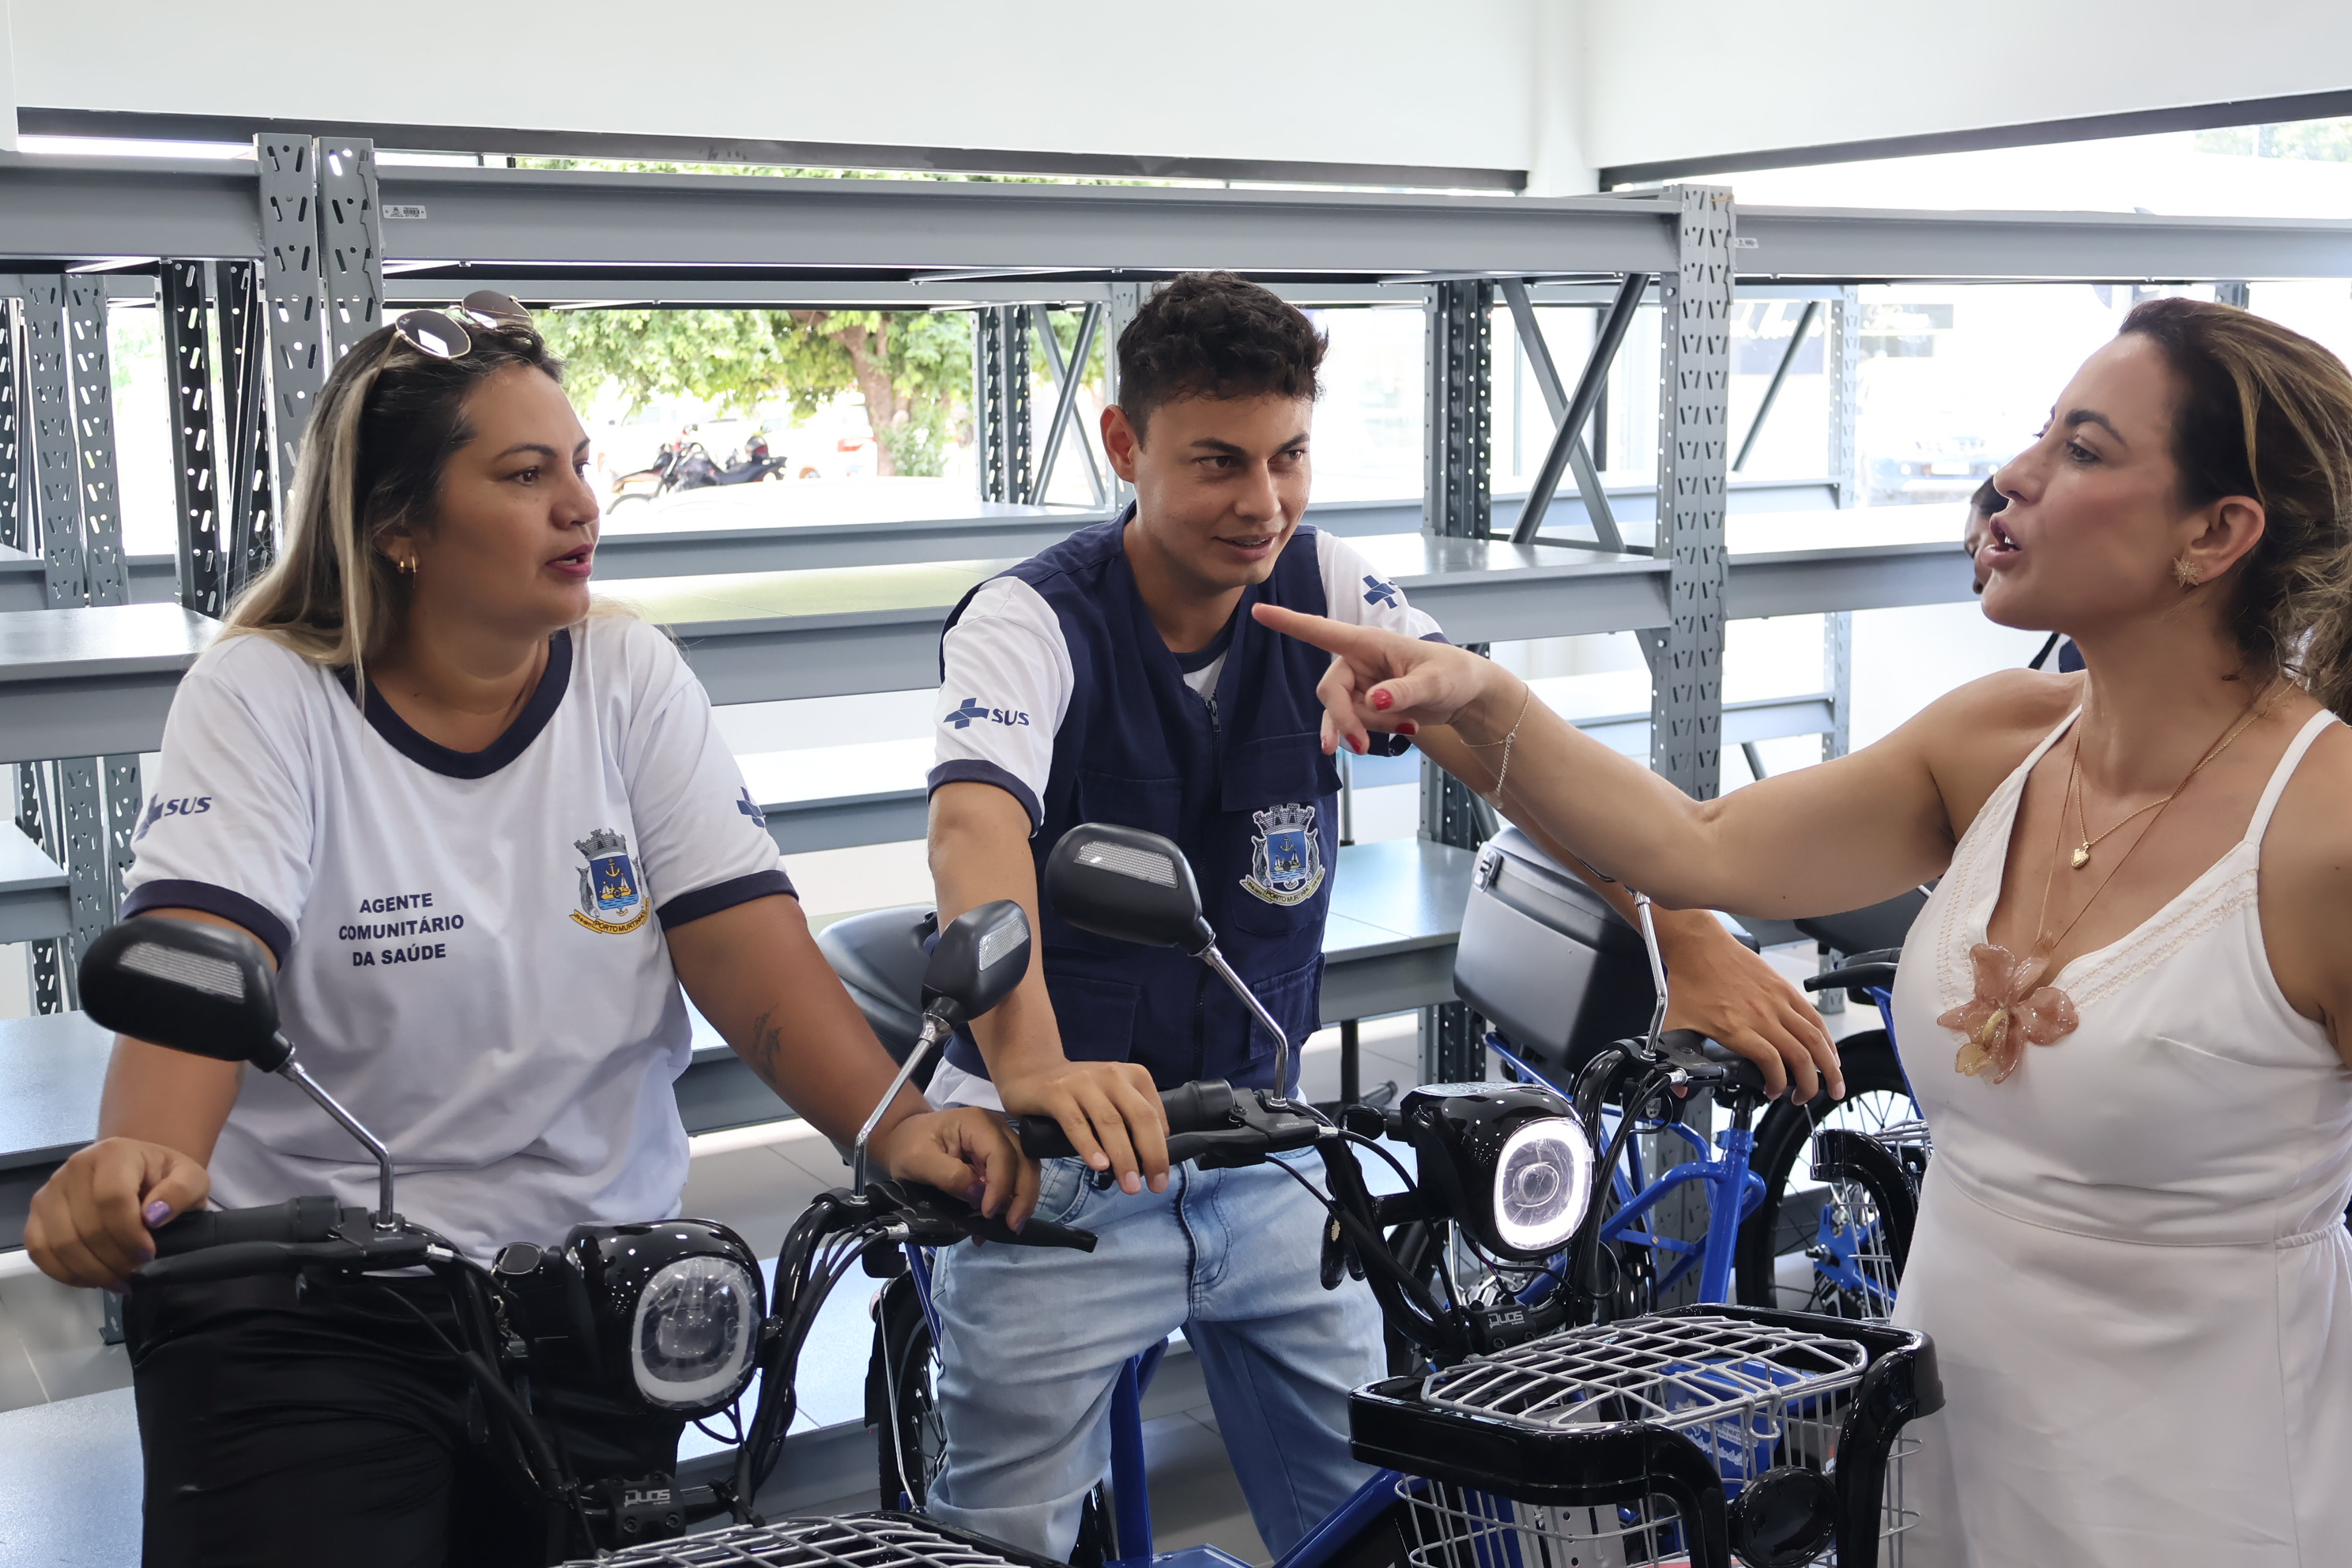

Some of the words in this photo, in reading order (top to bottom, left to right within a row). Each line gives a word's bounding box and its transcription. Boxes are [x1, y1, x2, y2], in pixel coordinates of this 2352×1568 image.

[991, 708, 1030, 726] SUS
[164, 796, 212, 817] SUS
[359, 892, 433, 914] AGENTE
[1265, 890, 1287, 903] PORTO
[1287, 884, 1310, 903] MURTINHO
[338, 914, 465, 940] COMUNITÁRIO
[594, 919, 618, 933] PORTO
[352, 951, 375, 967] DA
[381, 943, 447, 965] SAÚDE
